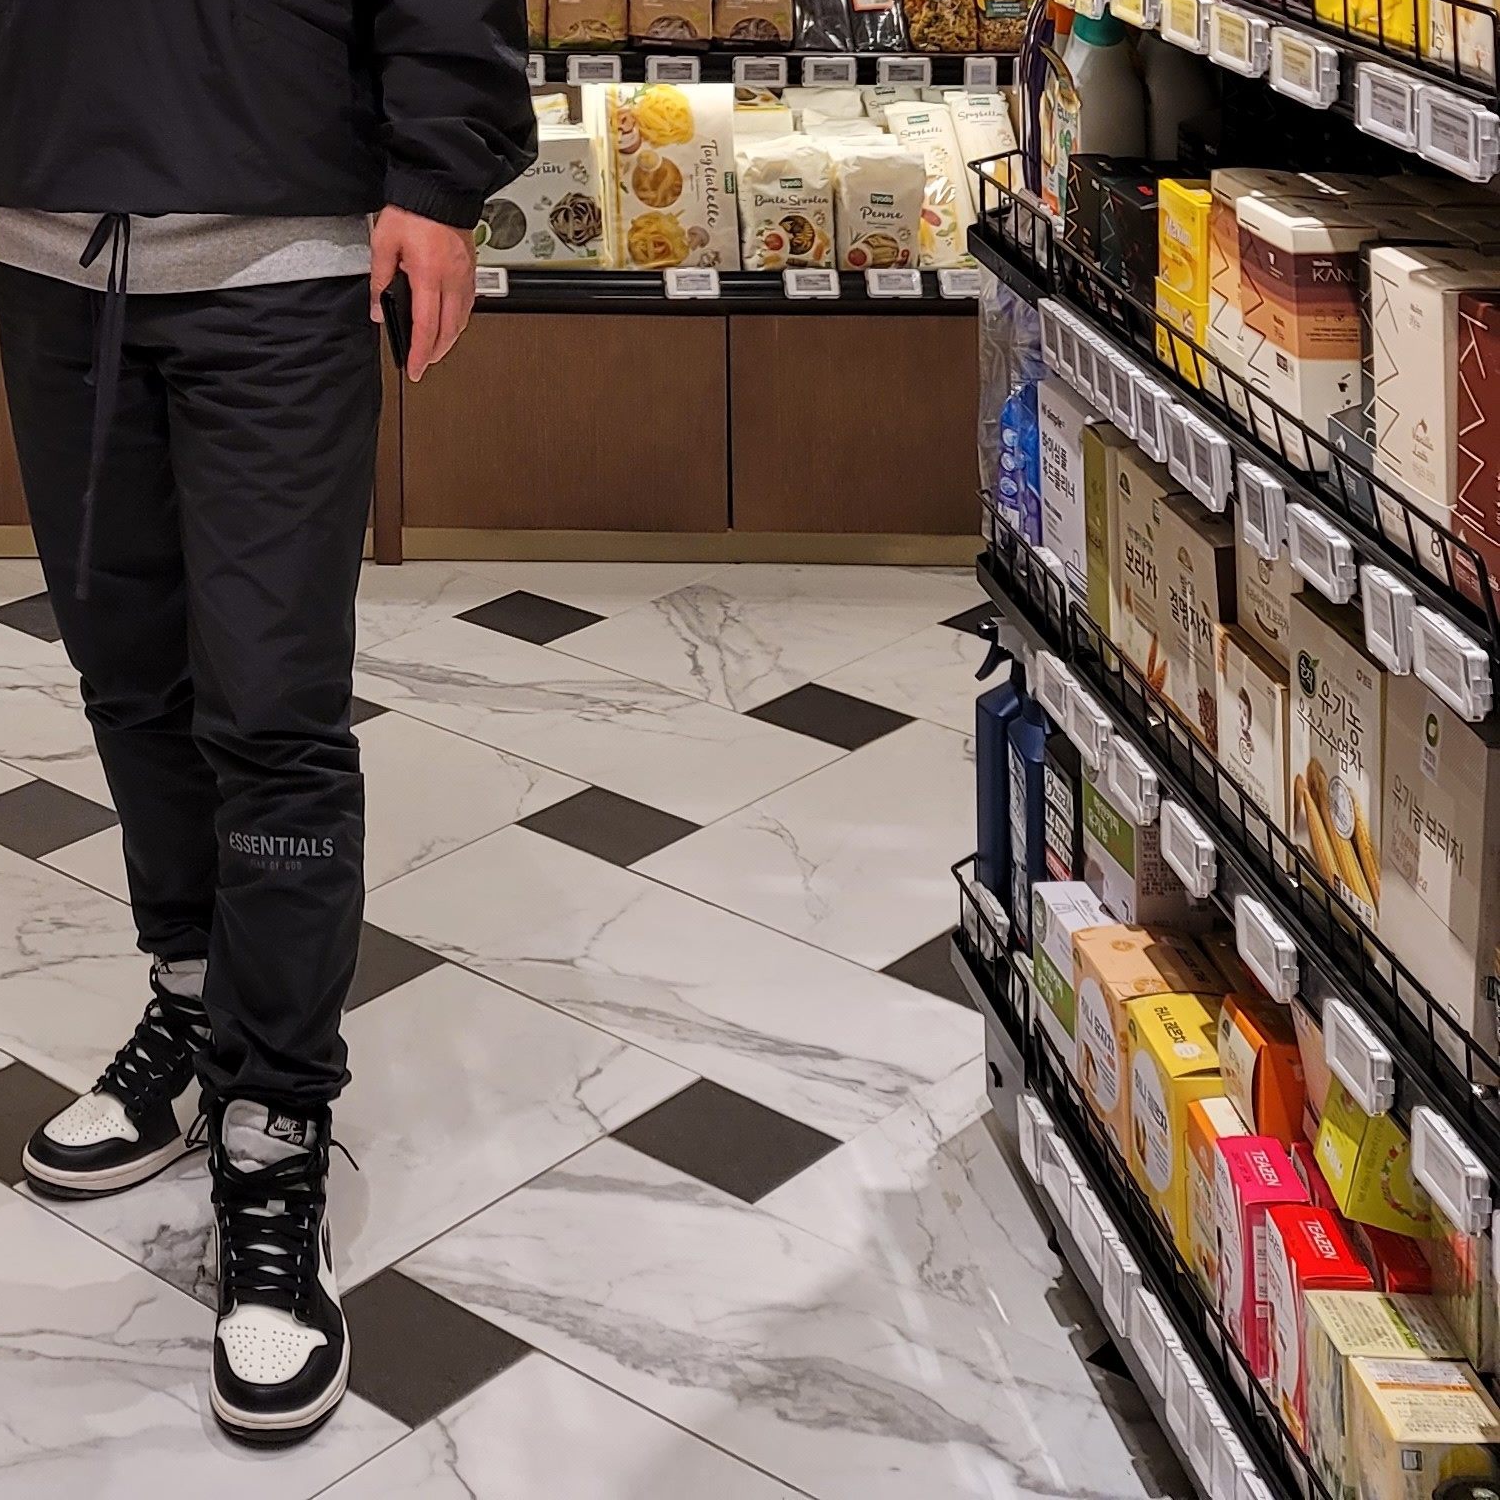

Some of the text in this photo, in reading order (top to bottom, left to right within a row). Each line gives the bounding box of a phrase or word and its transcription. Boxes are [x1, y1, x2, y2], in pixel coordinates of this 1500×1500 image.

[700, 140, 720, 227] Tagliatelle
[860, 206, 904, 220] Penne
[1164, 216, 1191, 247] Maxim
[1125, 540, 1158, 599] 보리차
[1168, 585, 1213, 656] 결명자차
[1317, 679, 1365, 746] 유기농
[229, 831, 334, 857] ESSENTIALS
[275, 1115, 298, 1131] NIKE
[1251, 1149, 1283, 1188] TEAZEN
[1305, 1219, 1340, 1261] TEAZEN
